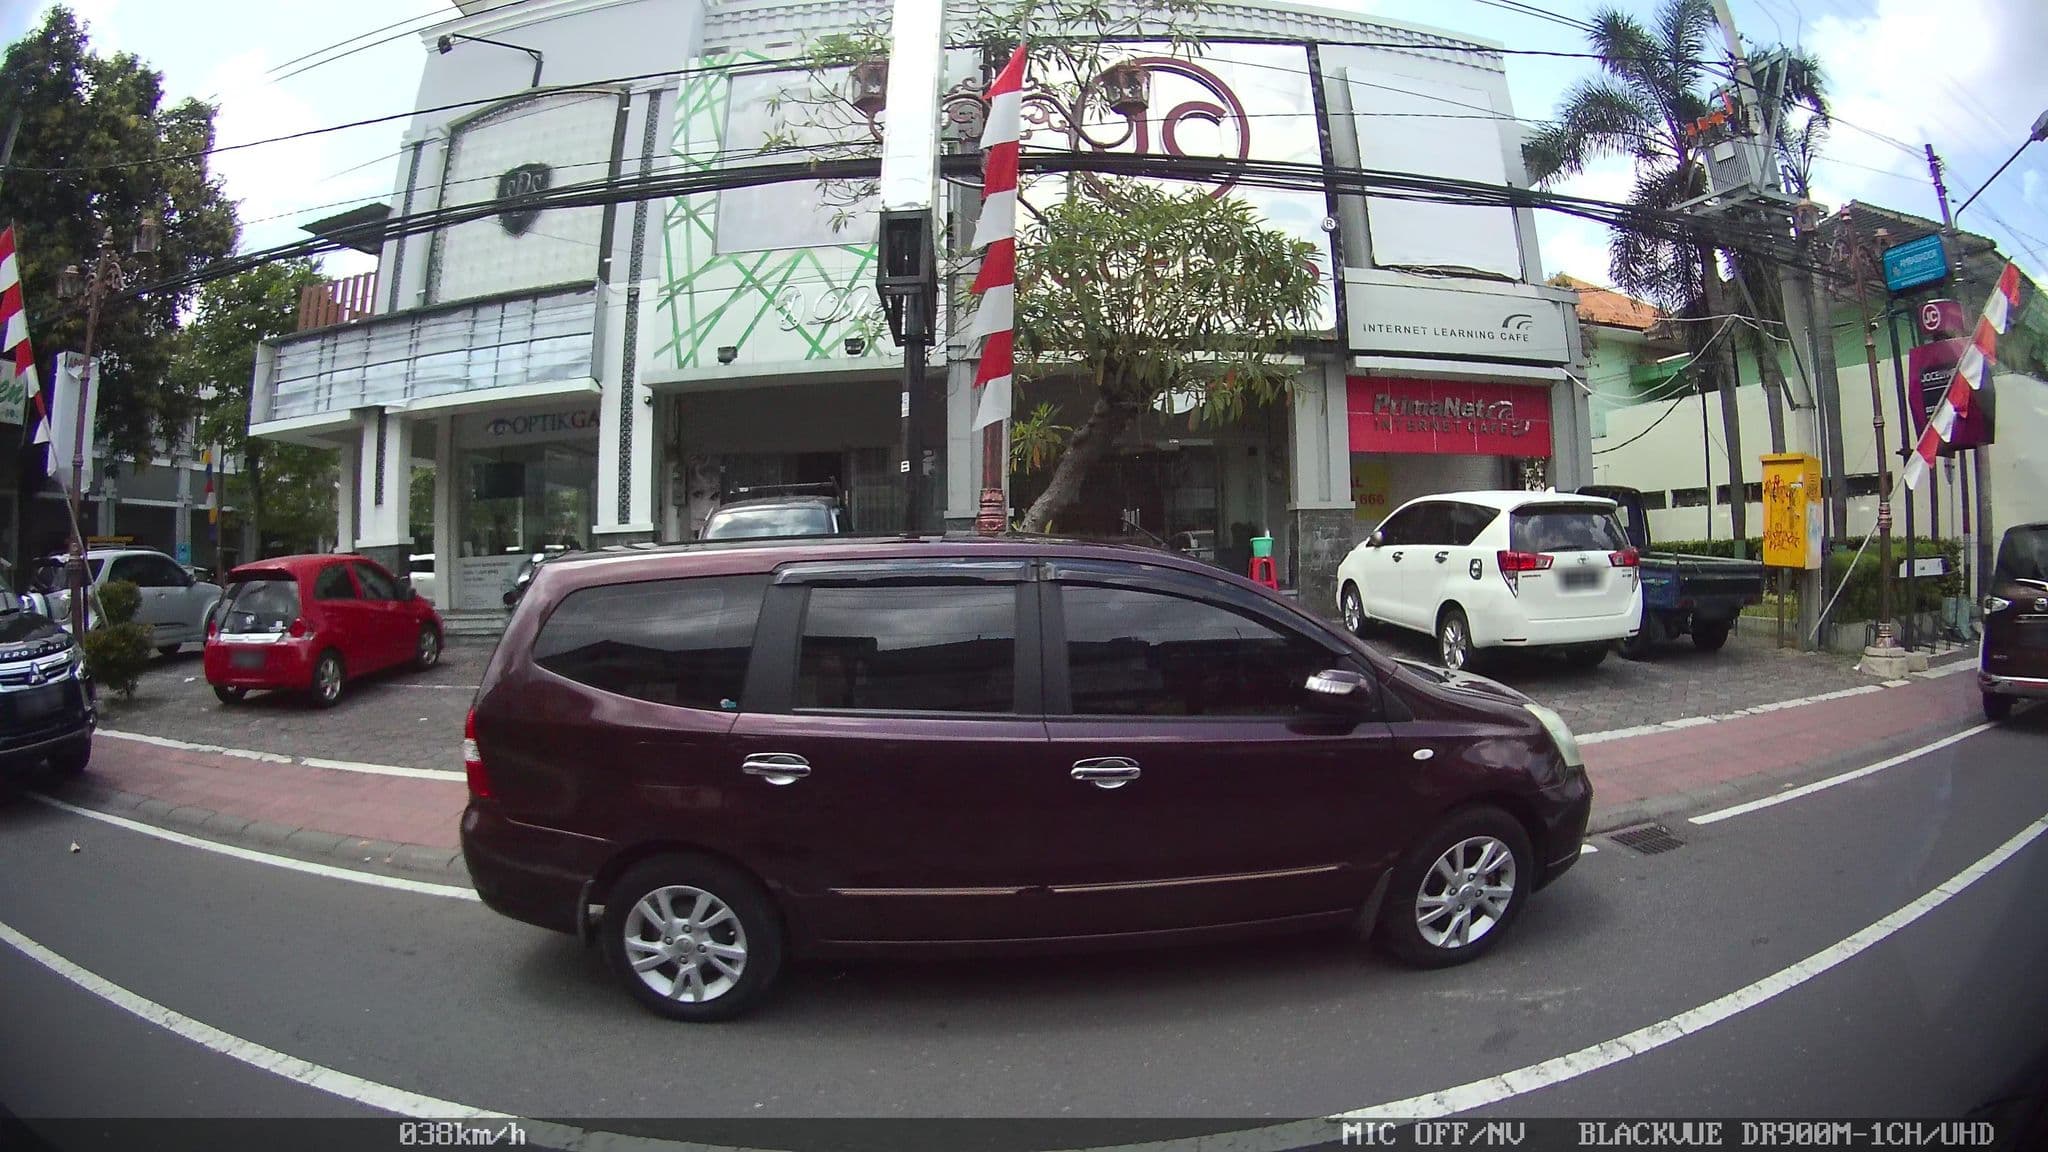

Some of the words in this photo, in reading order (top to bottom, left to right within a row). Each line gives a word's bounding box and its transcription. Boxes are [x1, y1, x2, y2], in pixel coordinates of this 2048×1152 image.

[1363, 323, 1428, 336] INTERNET
[1433, 327, 1495, 340] LEARNING
[1500, 332, 1529, 342] CAFE
[1374, 393, 1485, 418] PrimaNet
[1375, 417, 1462, 433] INTERNET
[1467, 421, 1508, 434] CAFE
